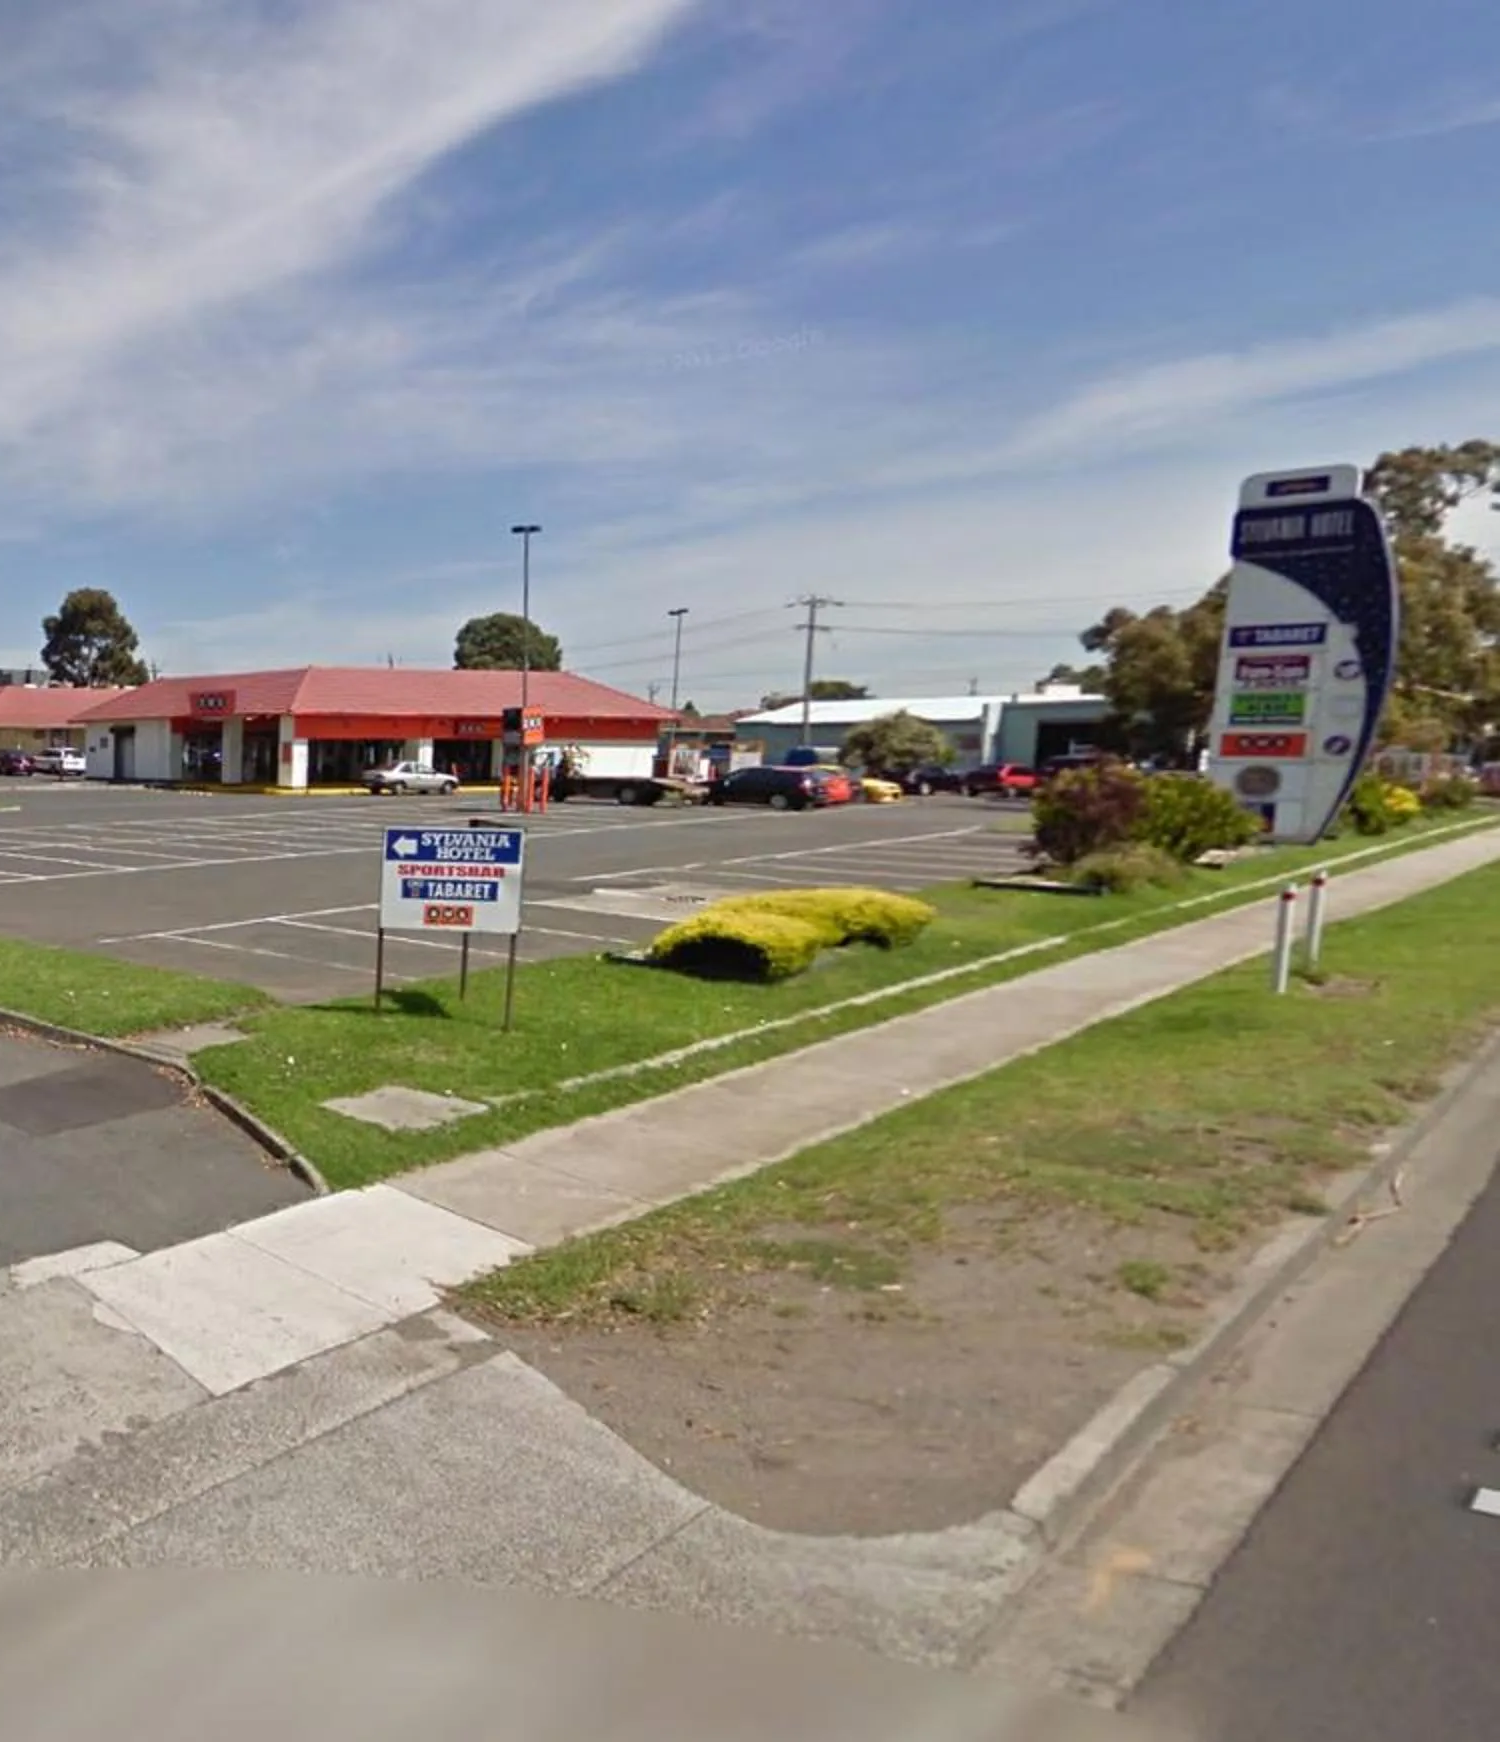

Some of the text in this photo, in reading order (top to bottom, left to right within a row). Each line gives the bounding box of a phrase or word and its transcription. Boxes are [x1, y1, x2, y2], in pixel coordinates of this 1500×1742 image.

[421, 832, 510, 848] SYLVANIA
[435, 847, 495, 861] HOTEL
[397, 864, 505, 878] SPORTSBAR
[427, 882, 491, 899] TABARET
